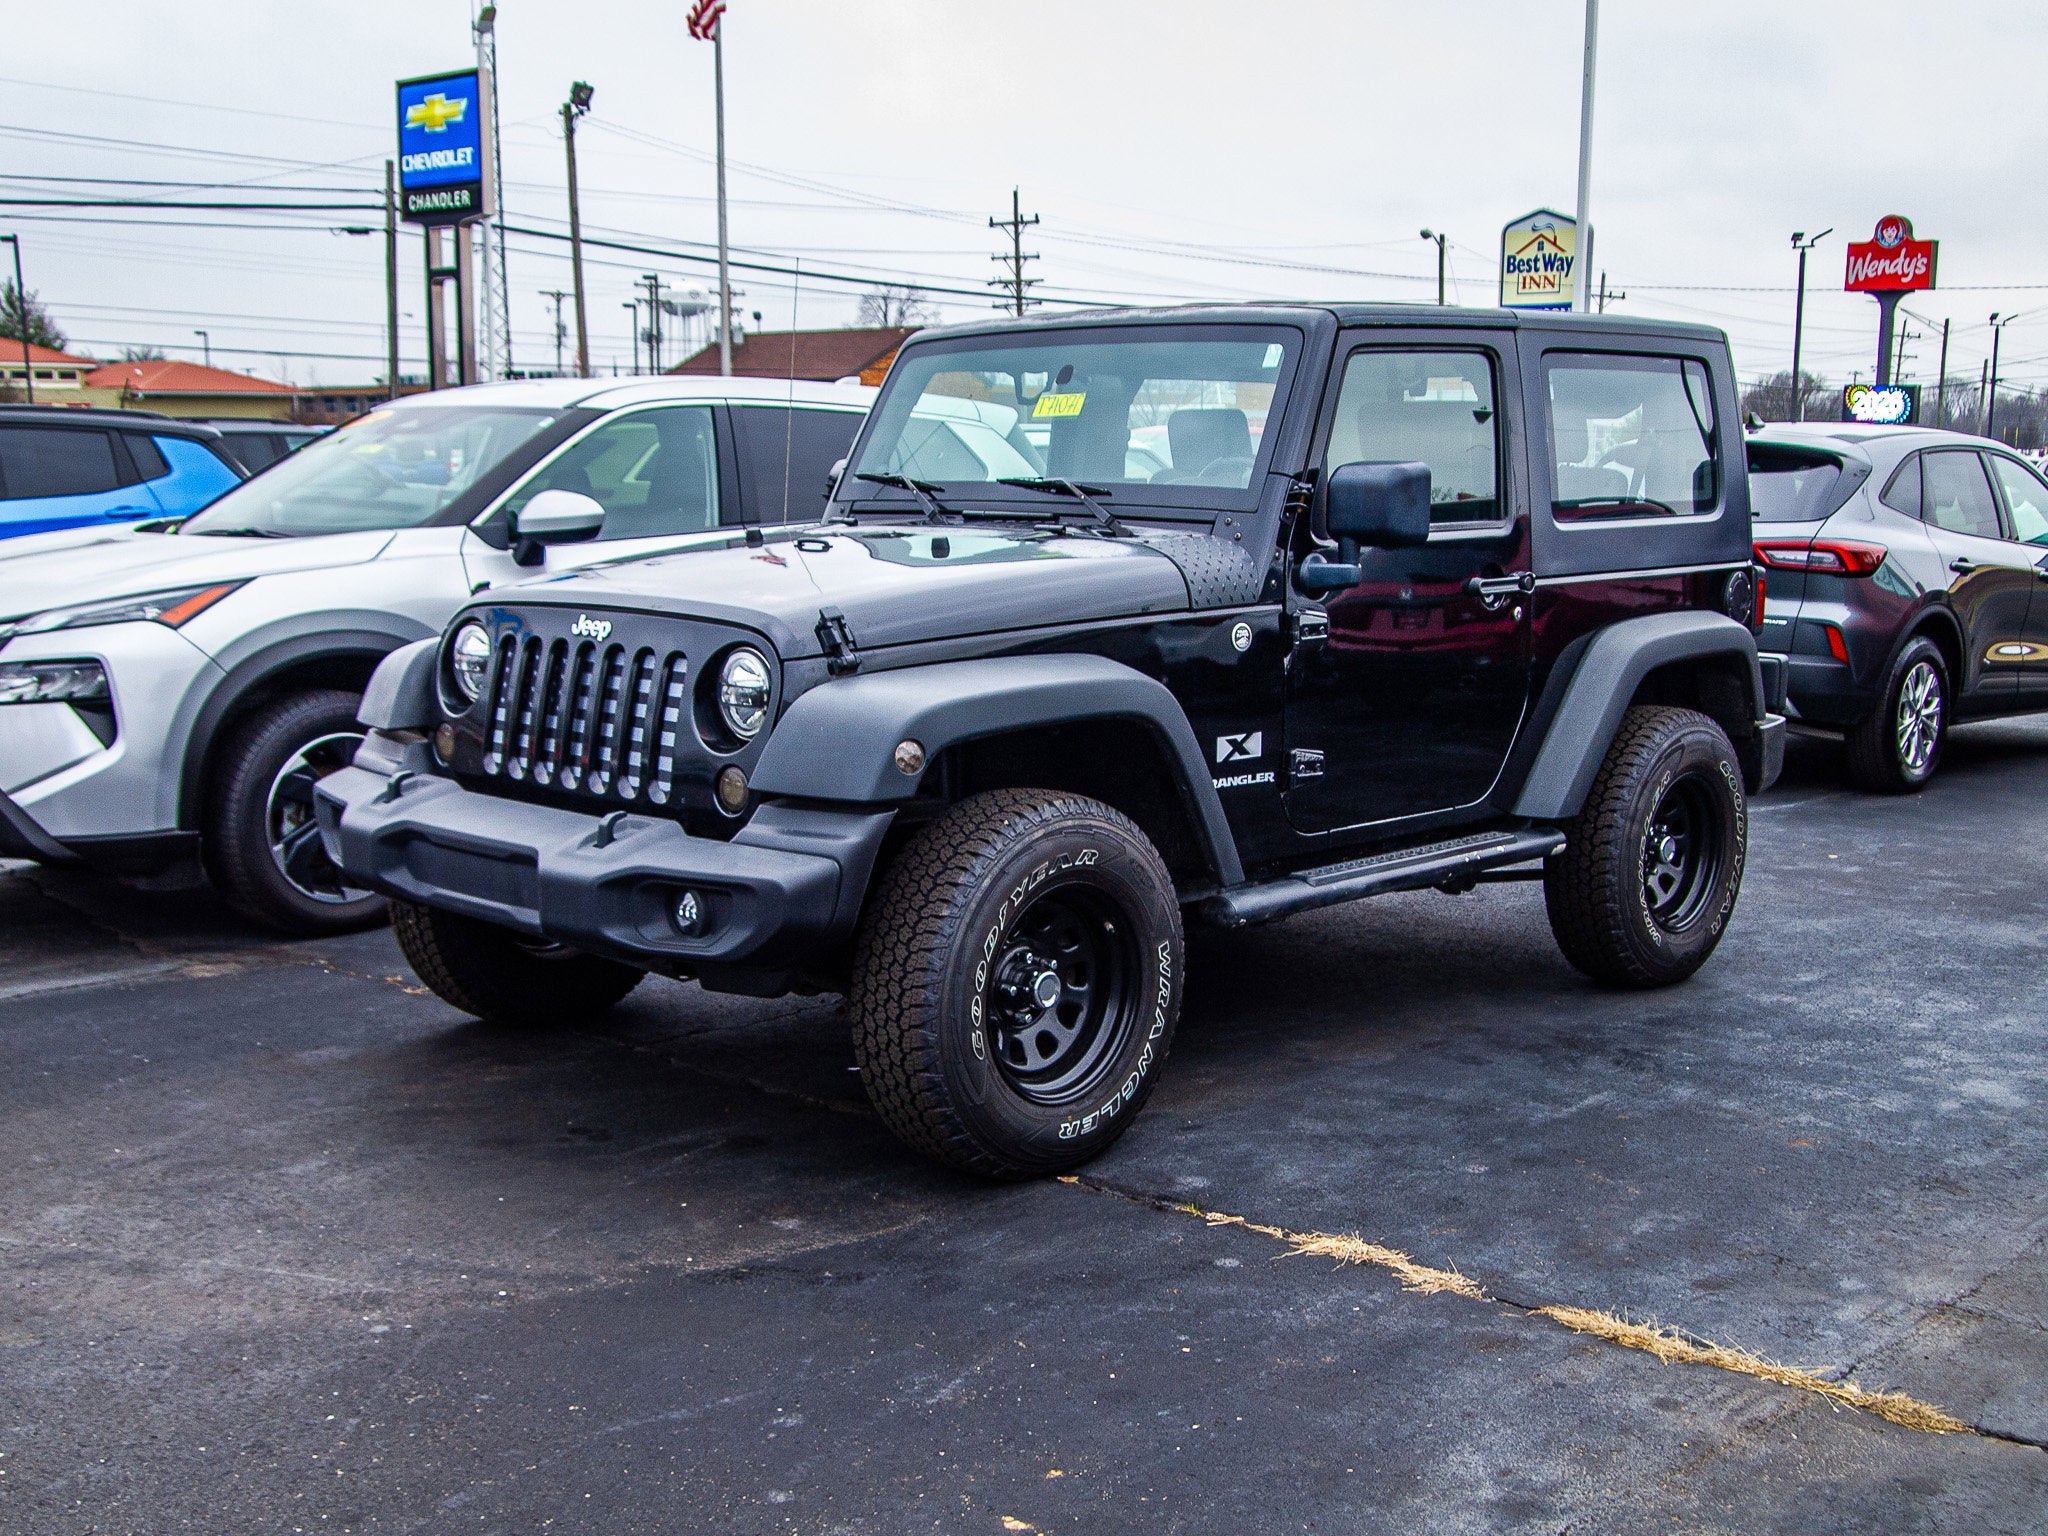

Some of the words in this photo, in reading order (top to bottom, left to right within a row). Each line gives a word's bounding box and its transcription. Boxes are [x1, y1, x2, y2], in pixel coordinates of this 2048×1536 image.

[402, 146, 473, 172] CHEVROLET
[408, 189, 471, 213] CHANDLER
[1506, 254, 1540, 274] Best
[1542, 252, 1574, 278] Way
[1848, 247, 1928, 285] Wendy's
[1521, 274, 1557, 290] INN
[571, 613, 612, 642] Jeep
[1212, 771, 1275, 789] RANGLER
[970, 848, 1099, 1061] GOODYEAR
[1058, 940, 1171, 1140] WRANGLER
